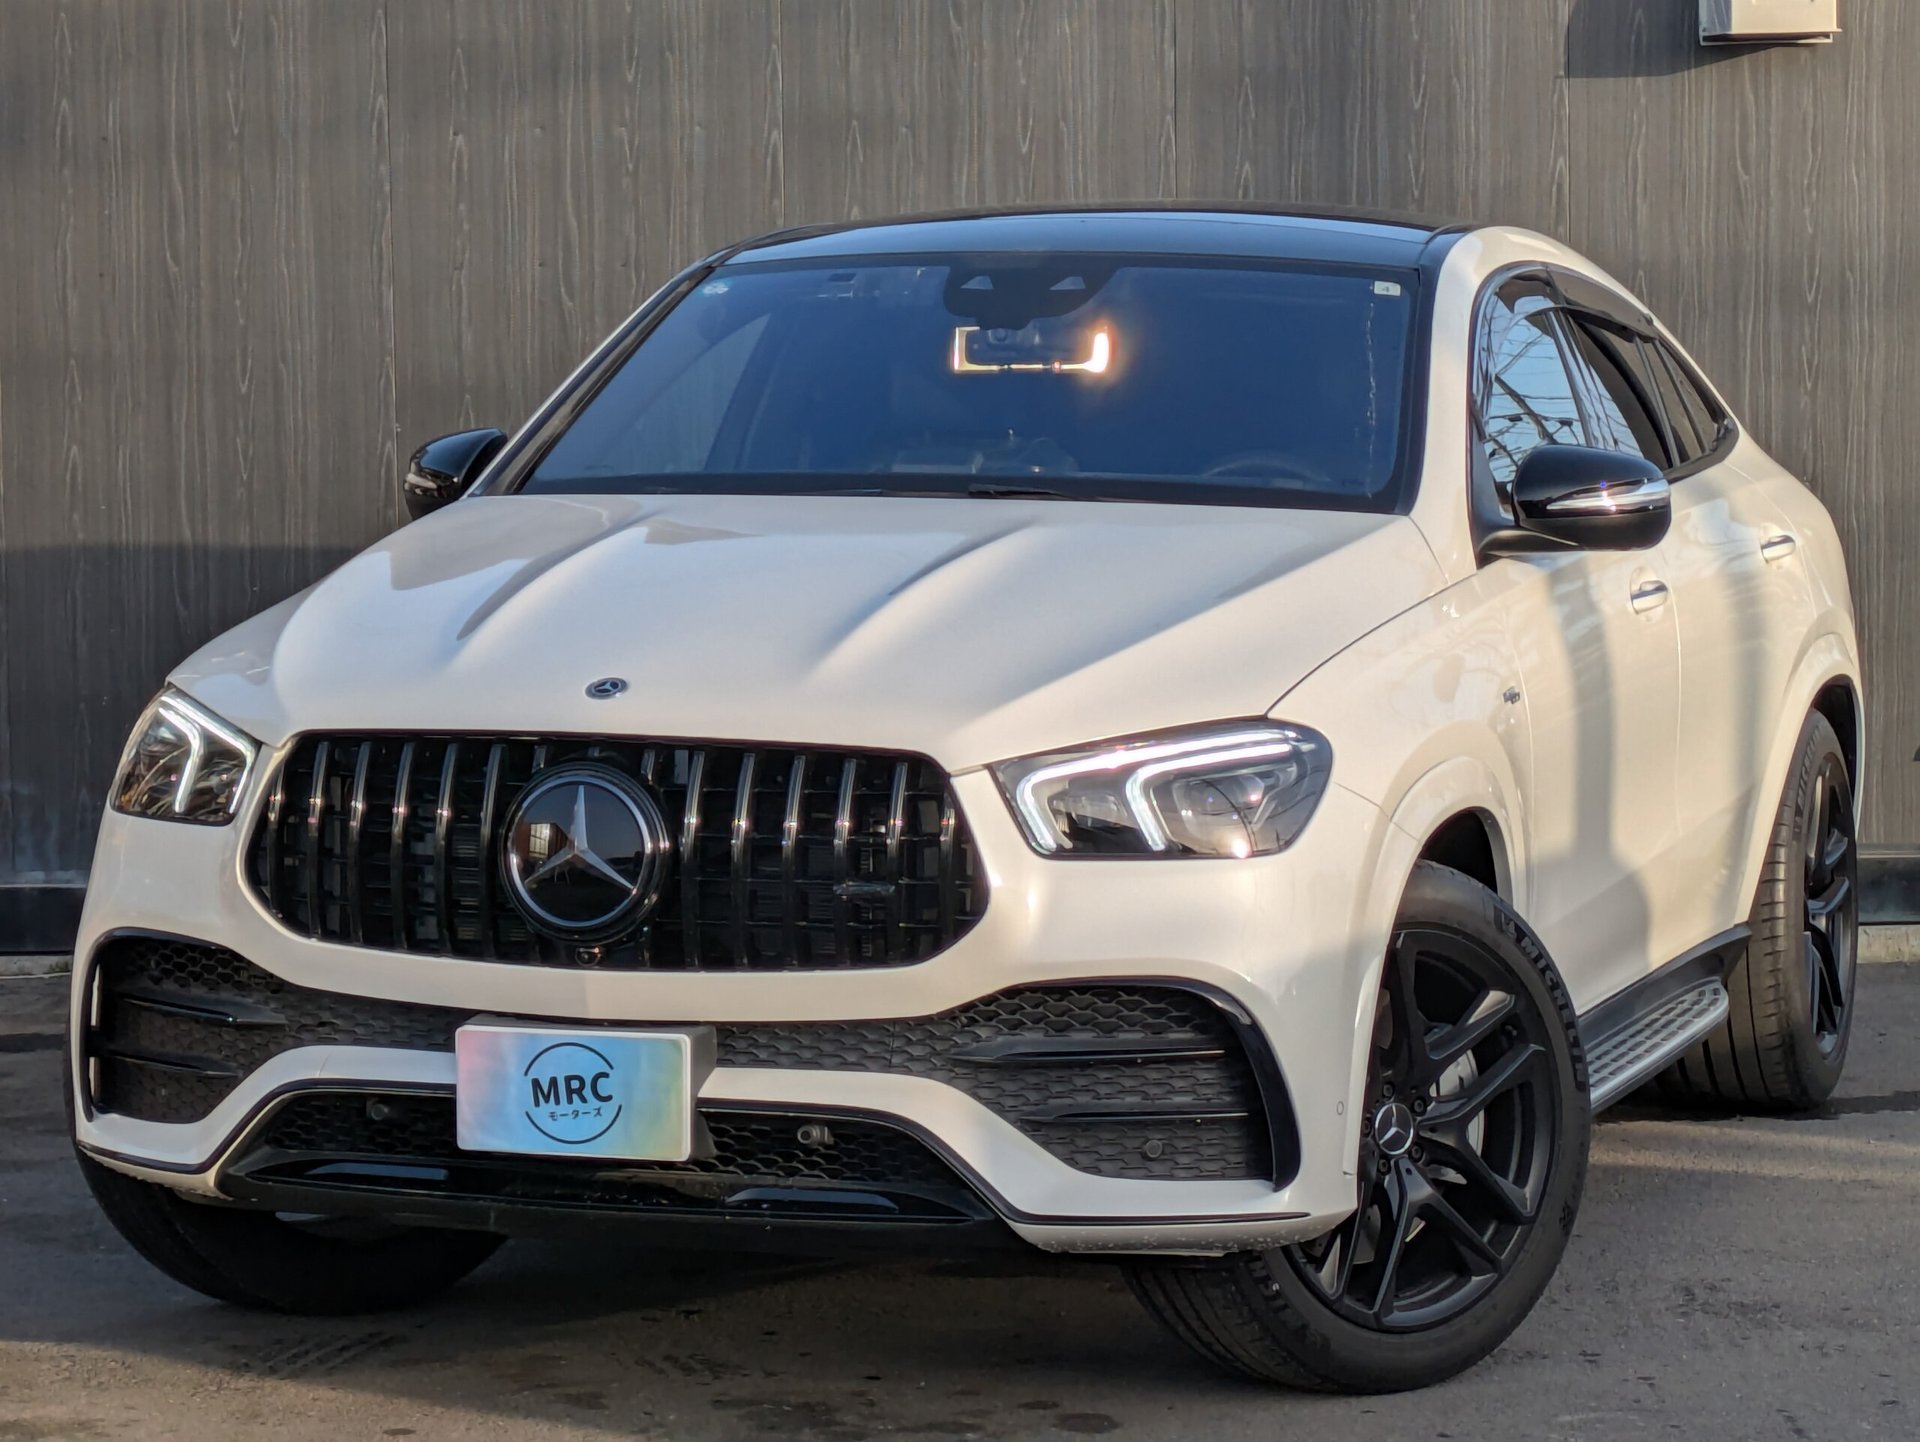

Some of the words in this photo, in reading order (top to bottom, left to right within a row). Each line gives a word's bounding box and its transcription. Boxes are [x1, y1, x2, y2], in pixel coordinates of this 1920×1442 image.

[531, 1072, 613, 1108] MRC
[548, 1106, 602, 1121] モーターズ
